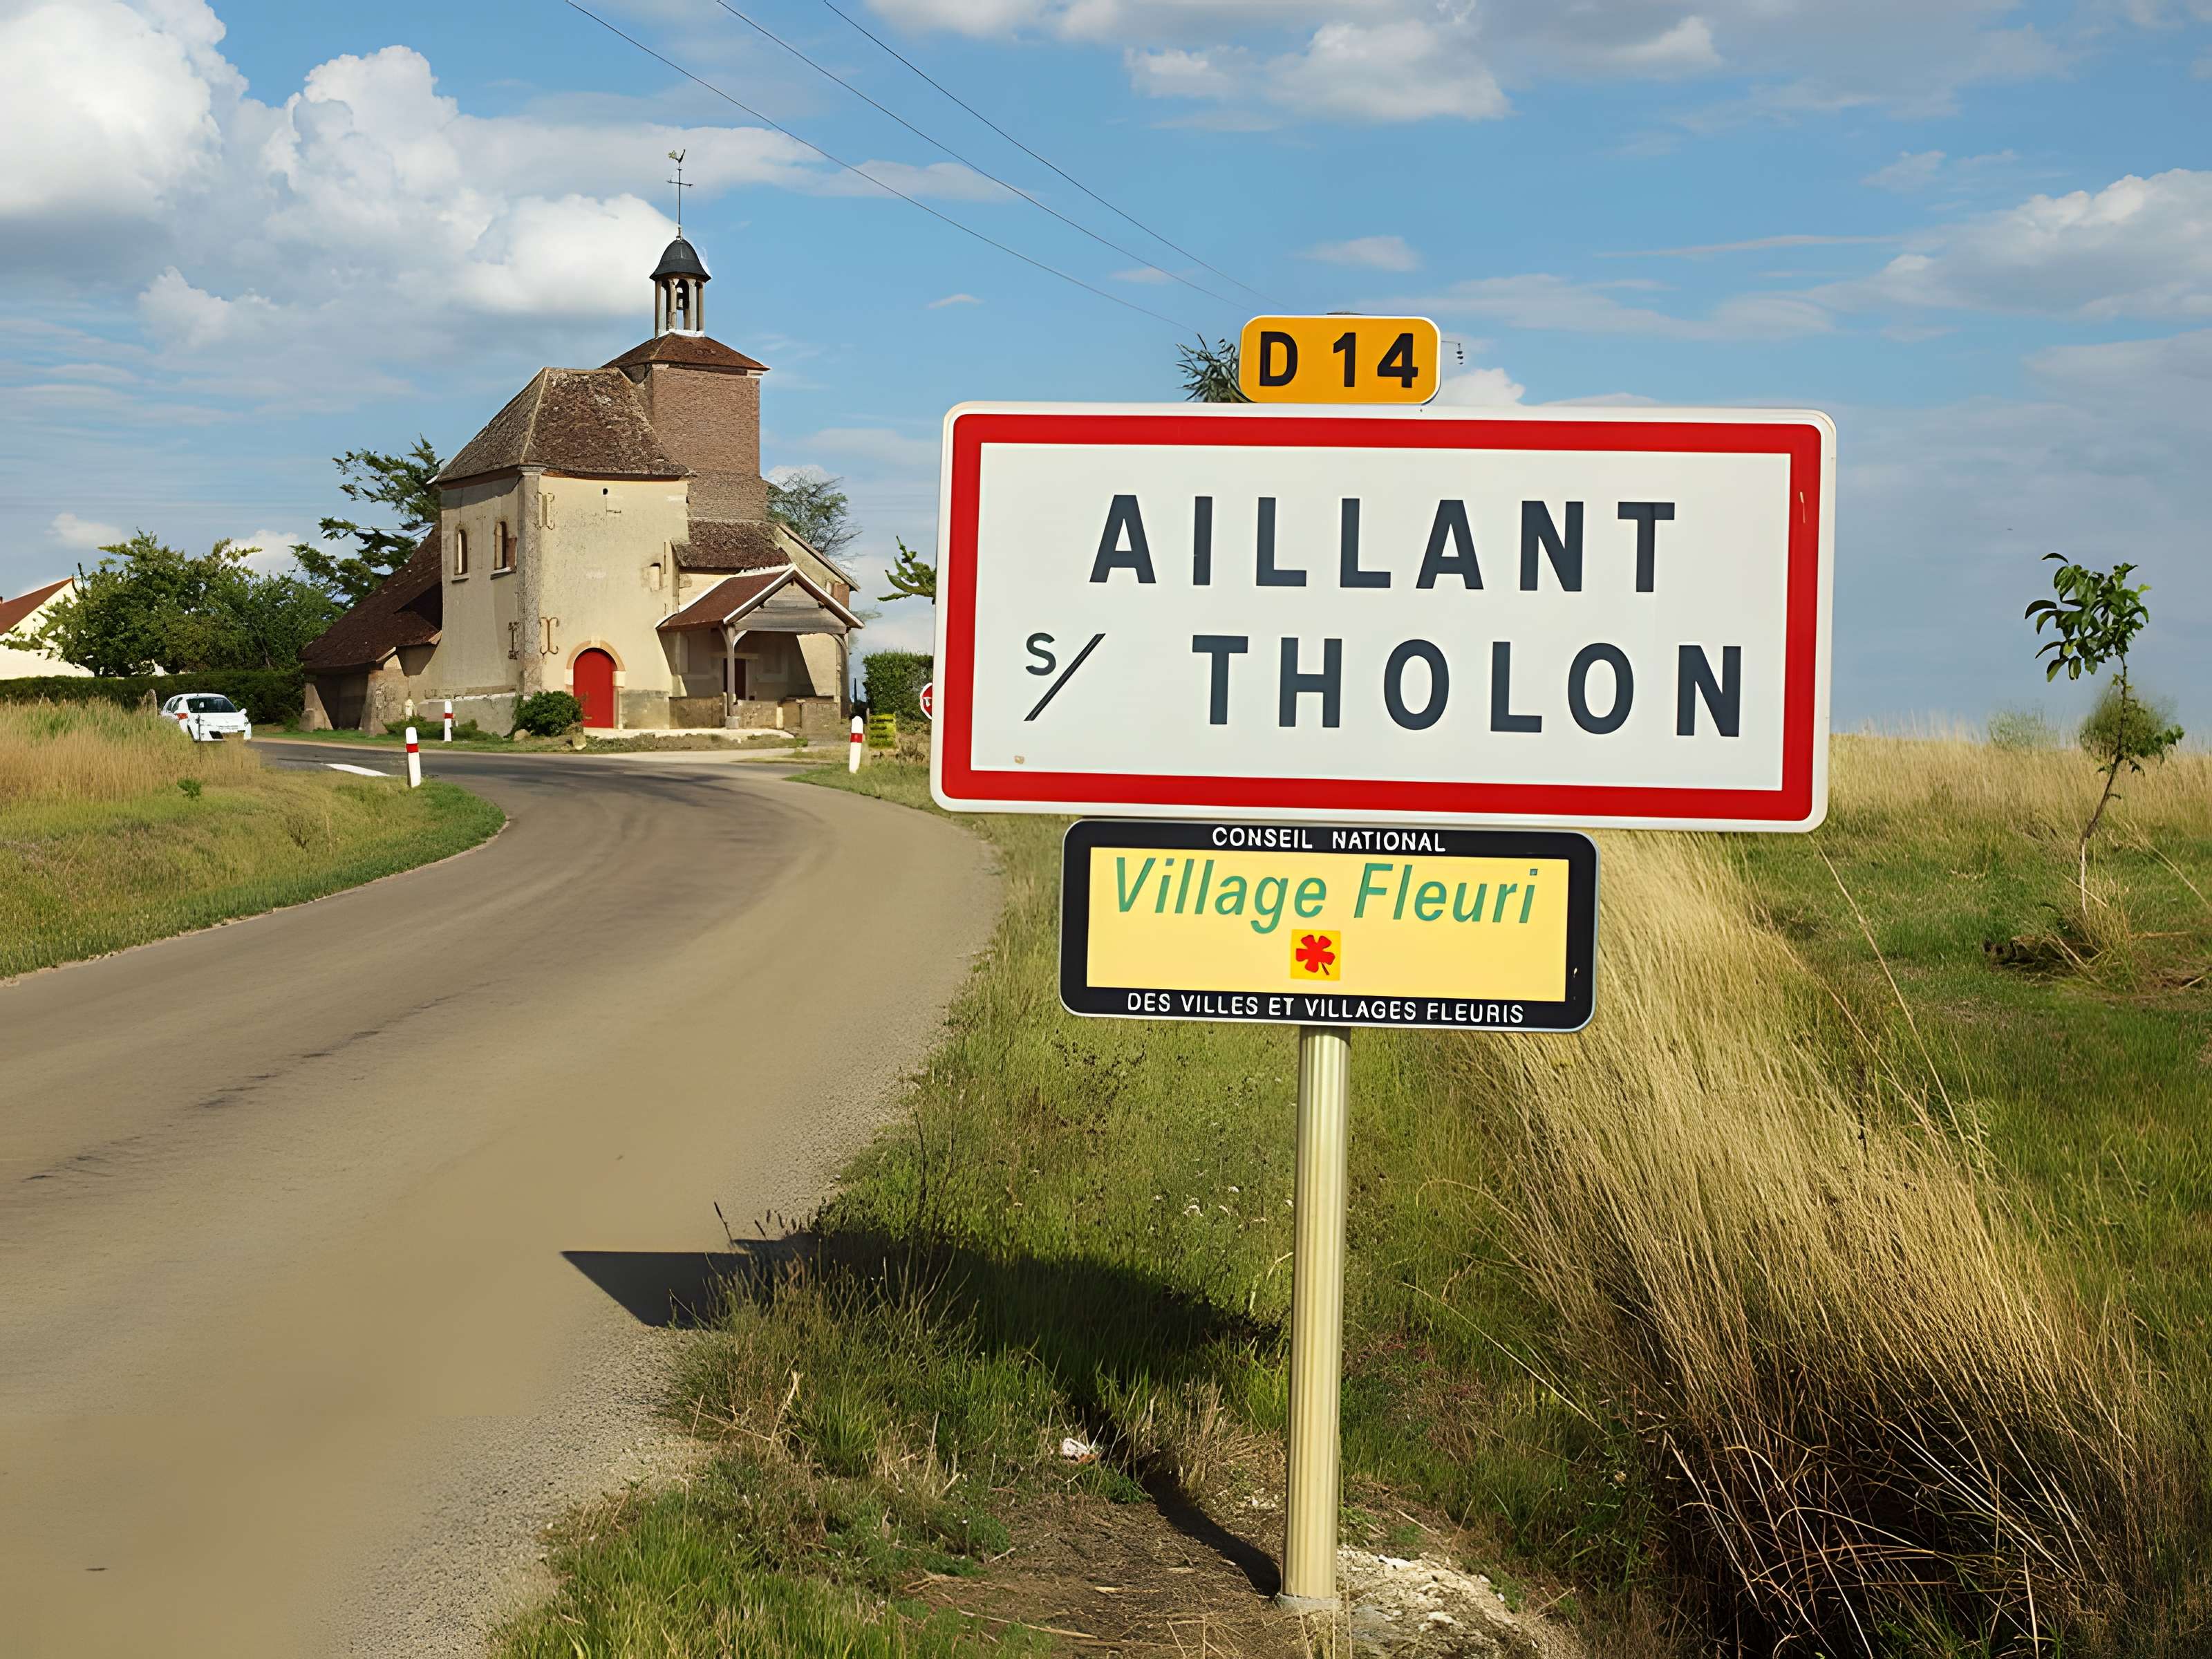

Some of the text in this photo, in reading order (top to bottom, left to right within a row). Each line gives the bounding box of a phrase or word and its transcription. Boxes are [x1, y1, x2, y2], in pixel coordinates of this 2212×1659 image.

[1259, 331, 1418, 388] D 14
[1089, 494, 1676, 593] AILLANT
[1192, 635, 1741, 738] THOLON
[1212, 827, 1446, 852] CONSEIL NATIONAL
[1116, 857, 1539, 934] Village Fleuri
[1127, 993, 1524, 1024] DES VILLES ET VILLAGES FLEURIS
